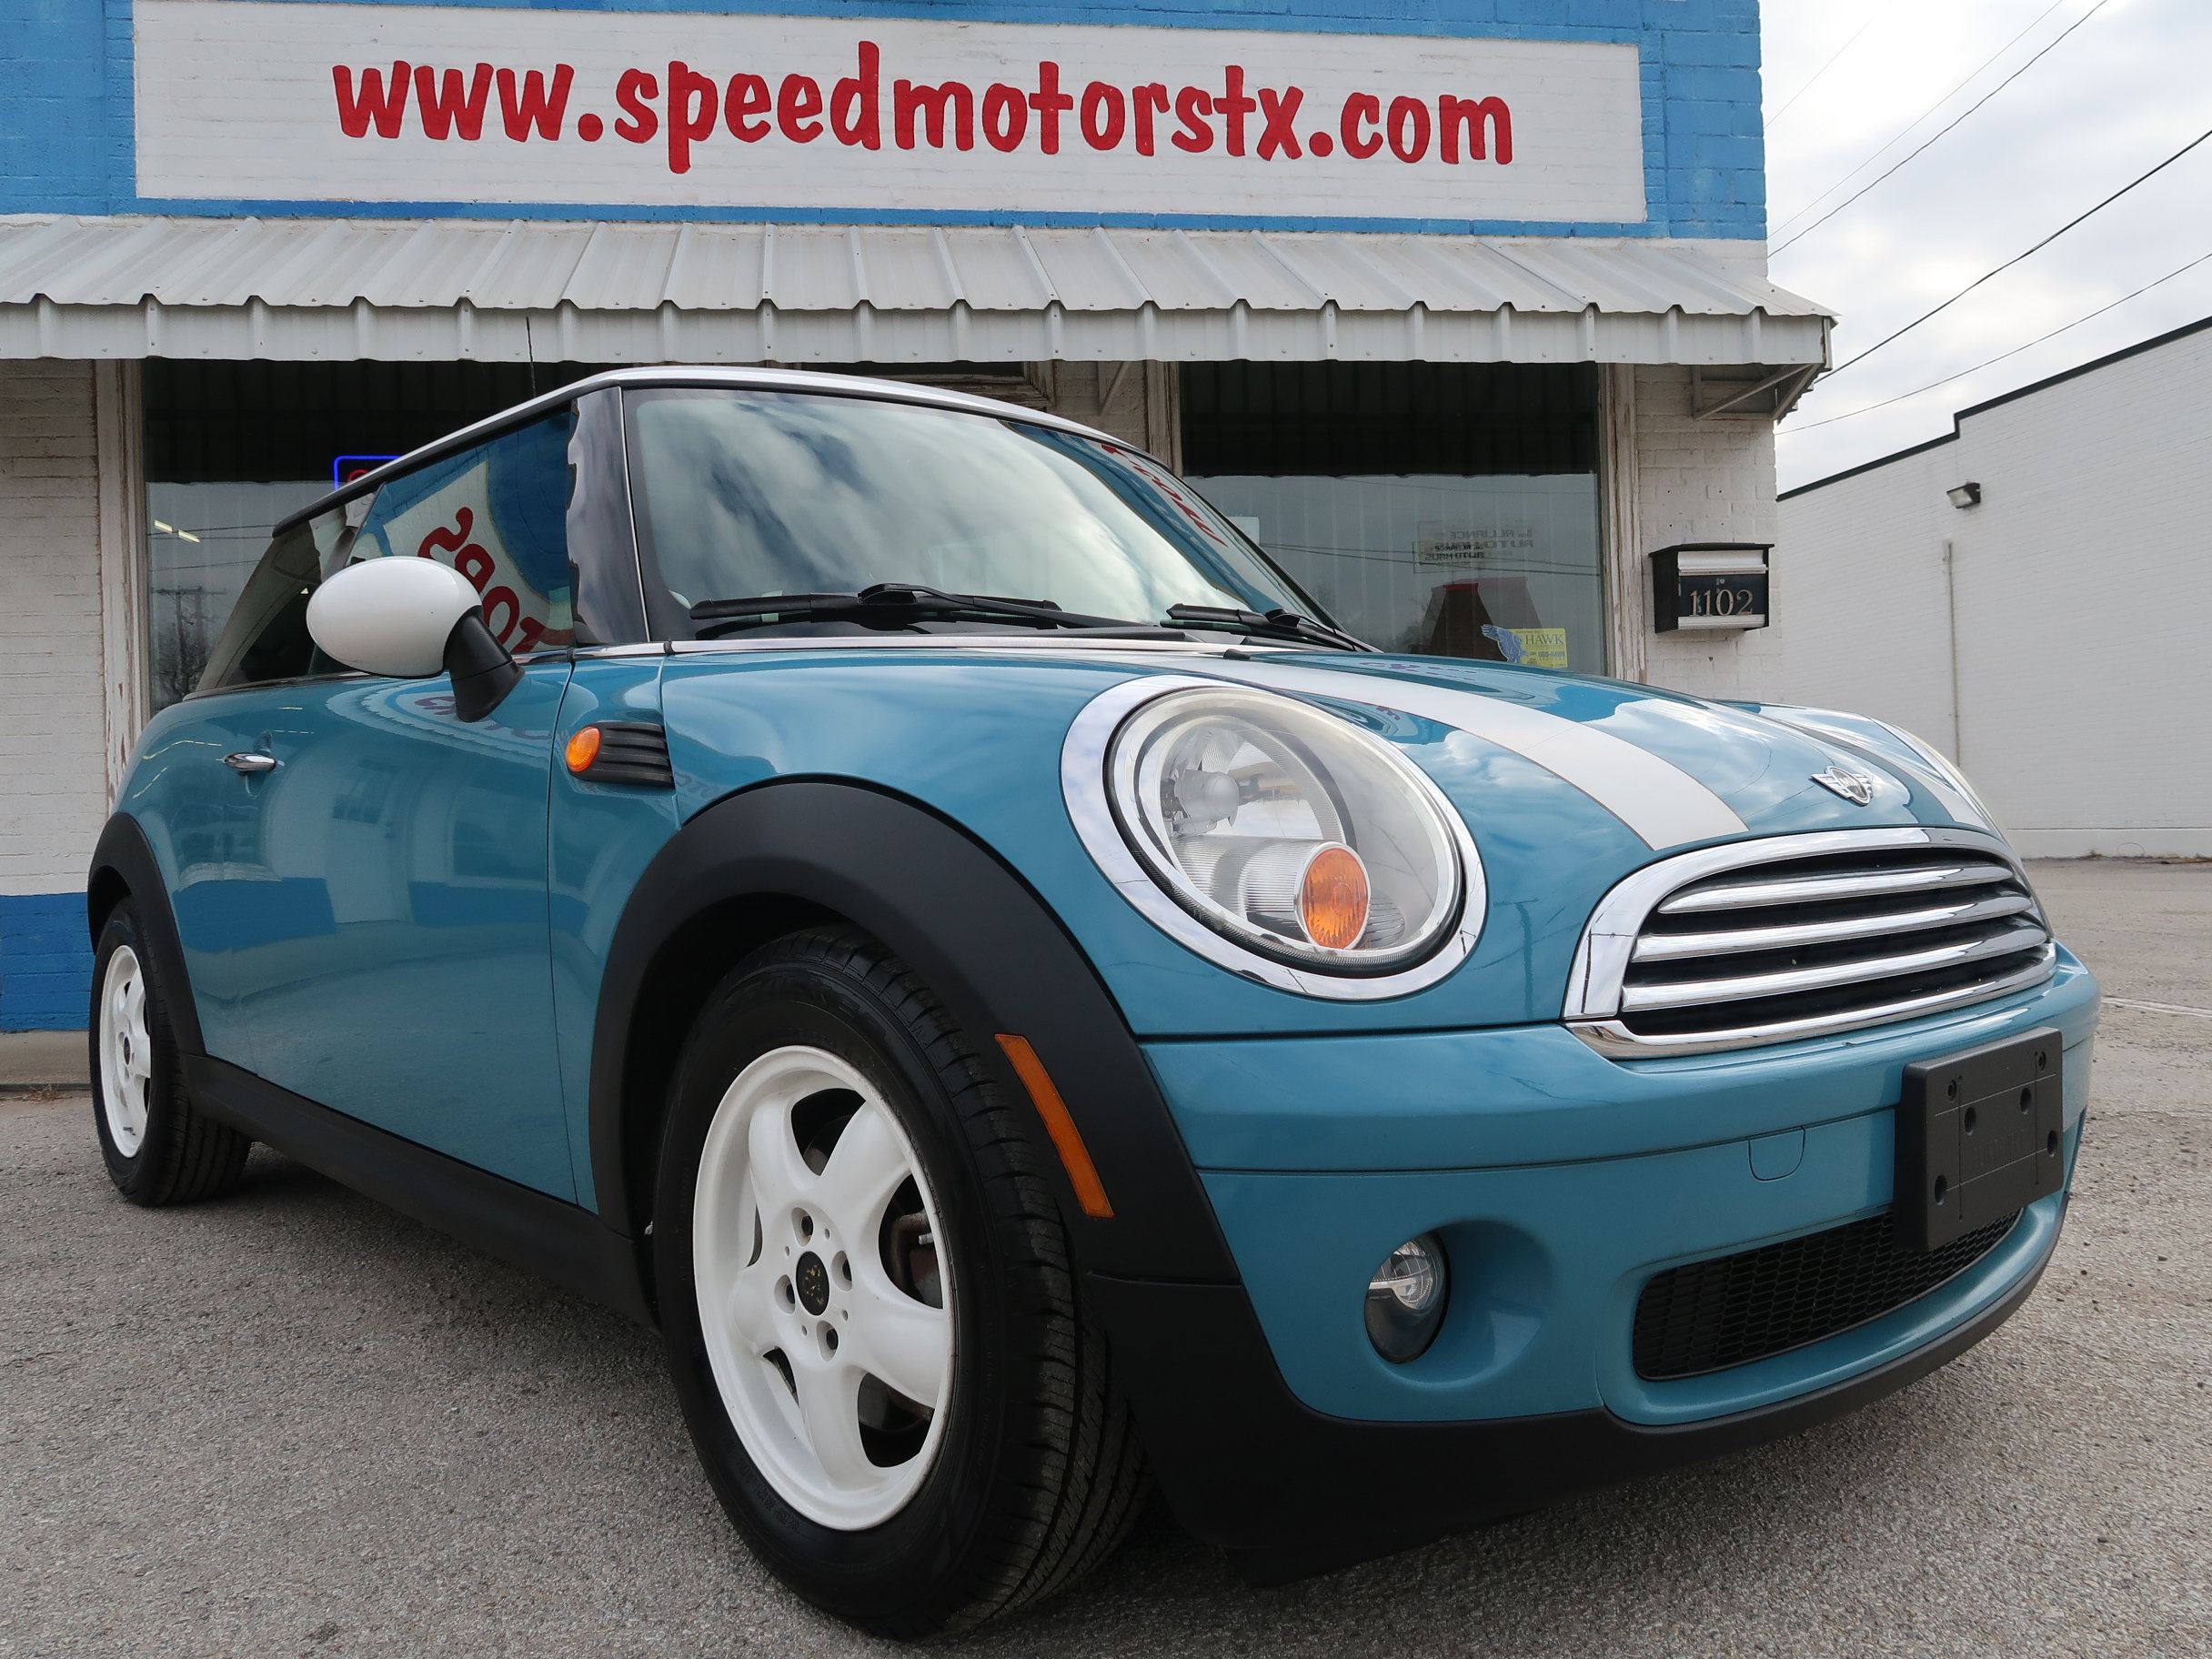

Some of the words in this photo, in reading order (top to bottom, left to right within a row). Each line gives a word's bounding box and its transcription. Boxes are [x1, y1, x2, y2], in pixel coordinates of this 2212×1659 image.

[333, 41, 1512, 174] www.speedmotorstx.com
[1689, 588, 1754, 617] 1102
[1525, 634, 1564, 645] HAWK
